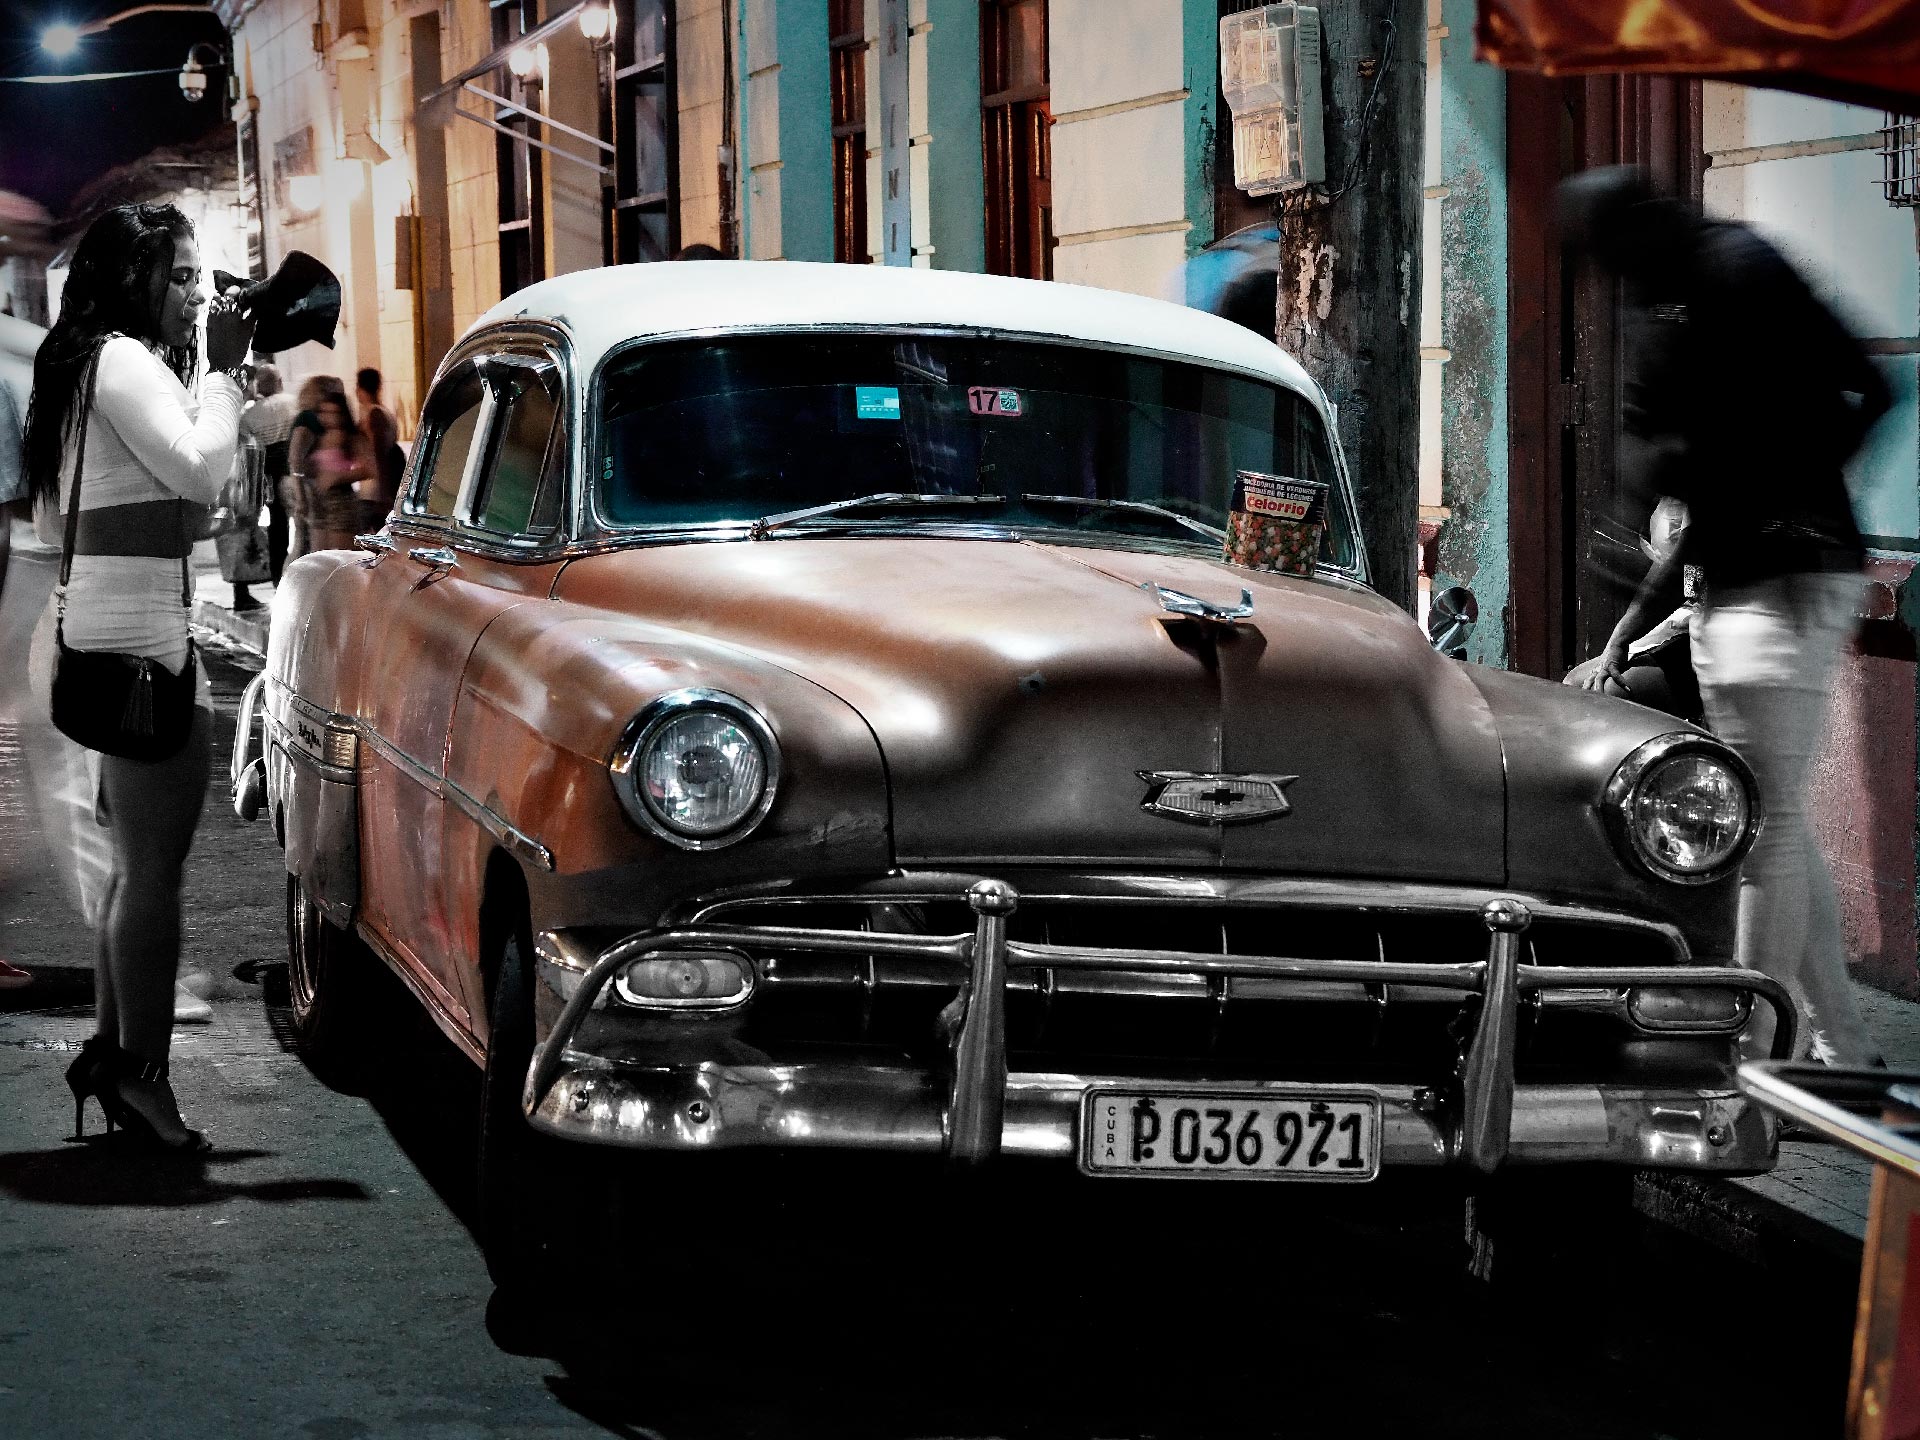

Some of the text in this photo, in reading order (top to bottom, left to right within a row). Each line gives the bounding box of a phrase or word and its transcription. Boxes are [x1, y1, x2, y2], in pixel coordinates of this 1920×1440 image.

[970, 389, 998, 412] 17
[1247, 495, 1306, 516] Celorrio
[1105, 1105, 1118, 1159] CUBA
[1172, 1107, 1264, 1166] 036
[1275, 1110, 1365, 1169] 971
